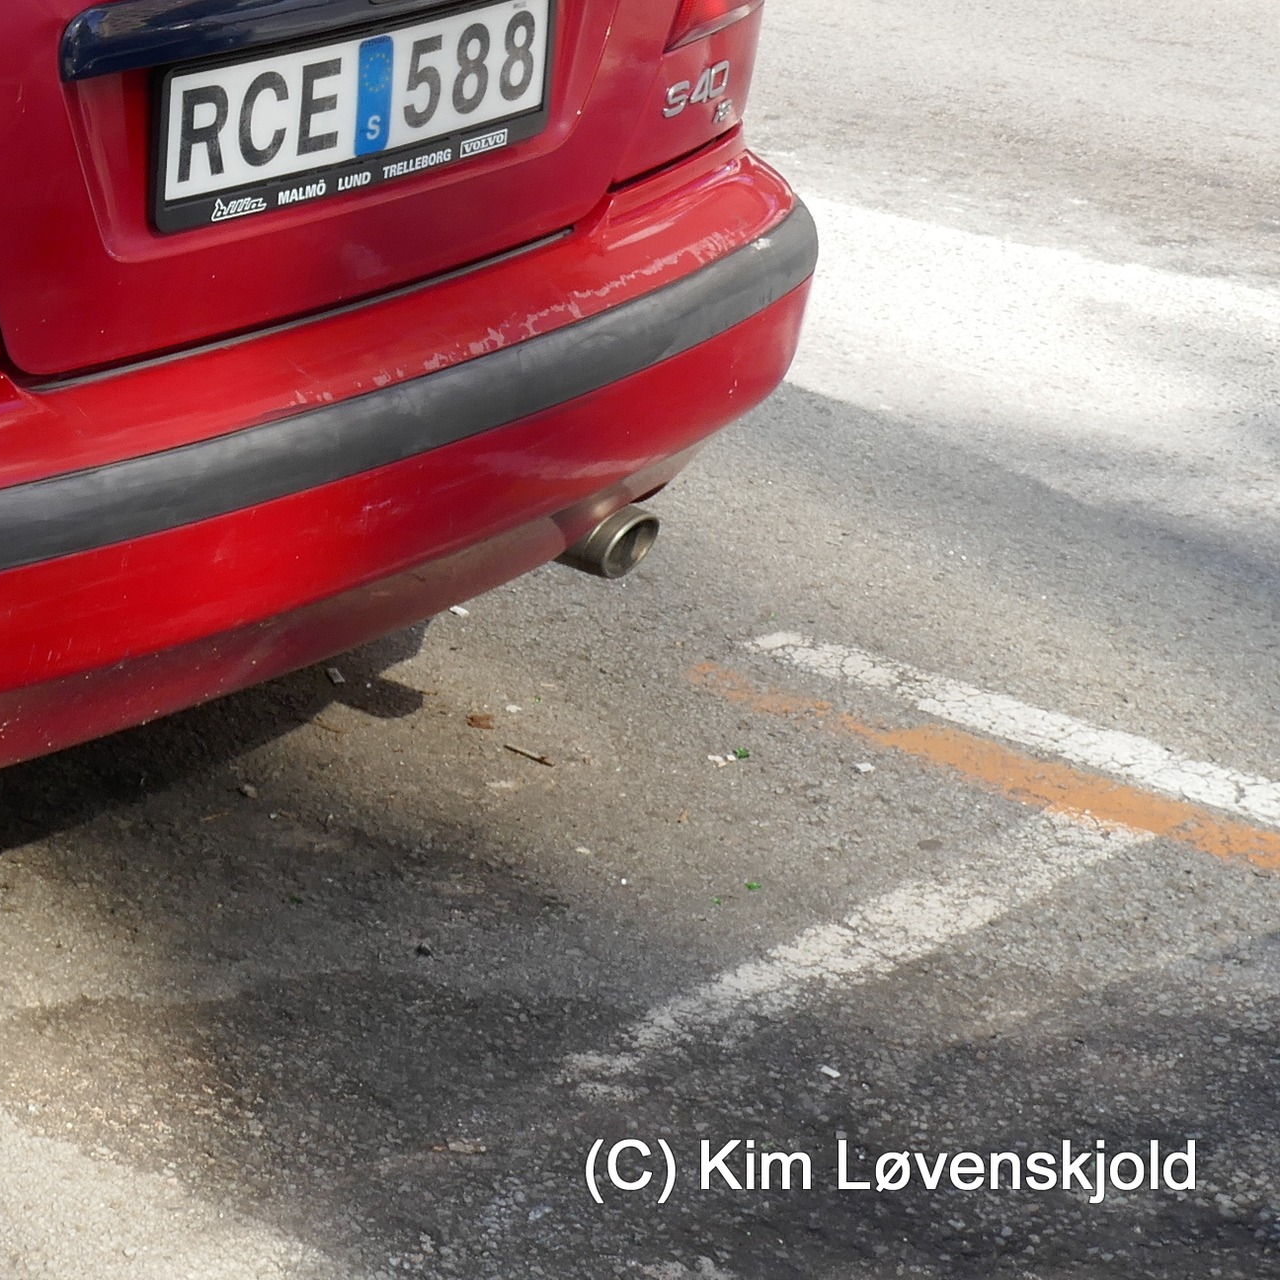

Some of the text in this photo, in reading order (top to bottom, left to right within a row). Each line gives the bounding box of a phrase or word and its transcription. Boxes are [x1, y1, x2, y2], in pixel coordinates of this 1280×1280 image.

[177, 10, 536, 184] RCE S 588
[663, 61, 730, 118] S40
[278, 179, 326, 205] MALMÖ
[338, 171, 371, 191] LUND
[382, 148, 452, 179] TRELLEBORG
[463, 131, 505, 153] VOLVO
